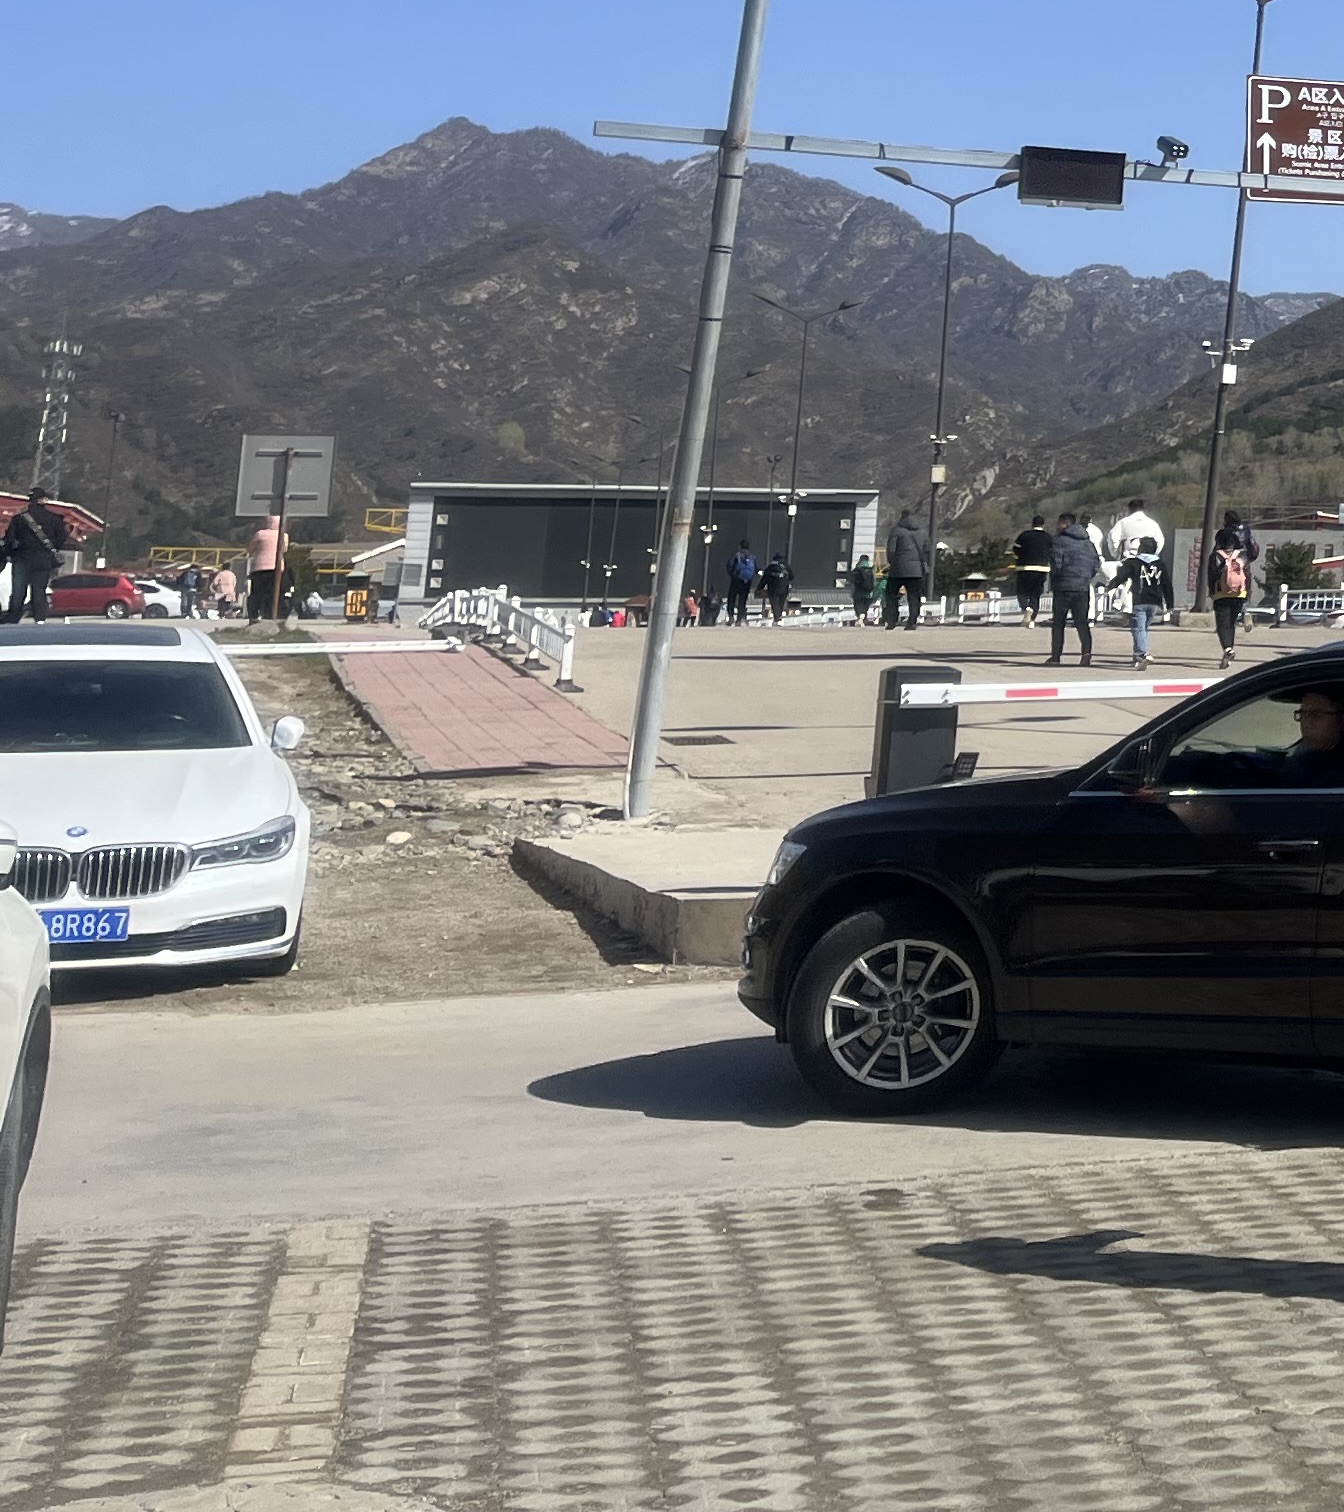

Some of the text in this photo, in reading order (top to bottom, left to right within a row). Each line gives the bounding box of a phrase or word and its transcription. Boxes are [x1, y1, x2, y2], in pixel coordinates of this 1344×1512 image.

[1256, 84, 1291, 123] P
[1307, 129, 1343, 144] 景区
[49, 912, 128, 938] 8R867
